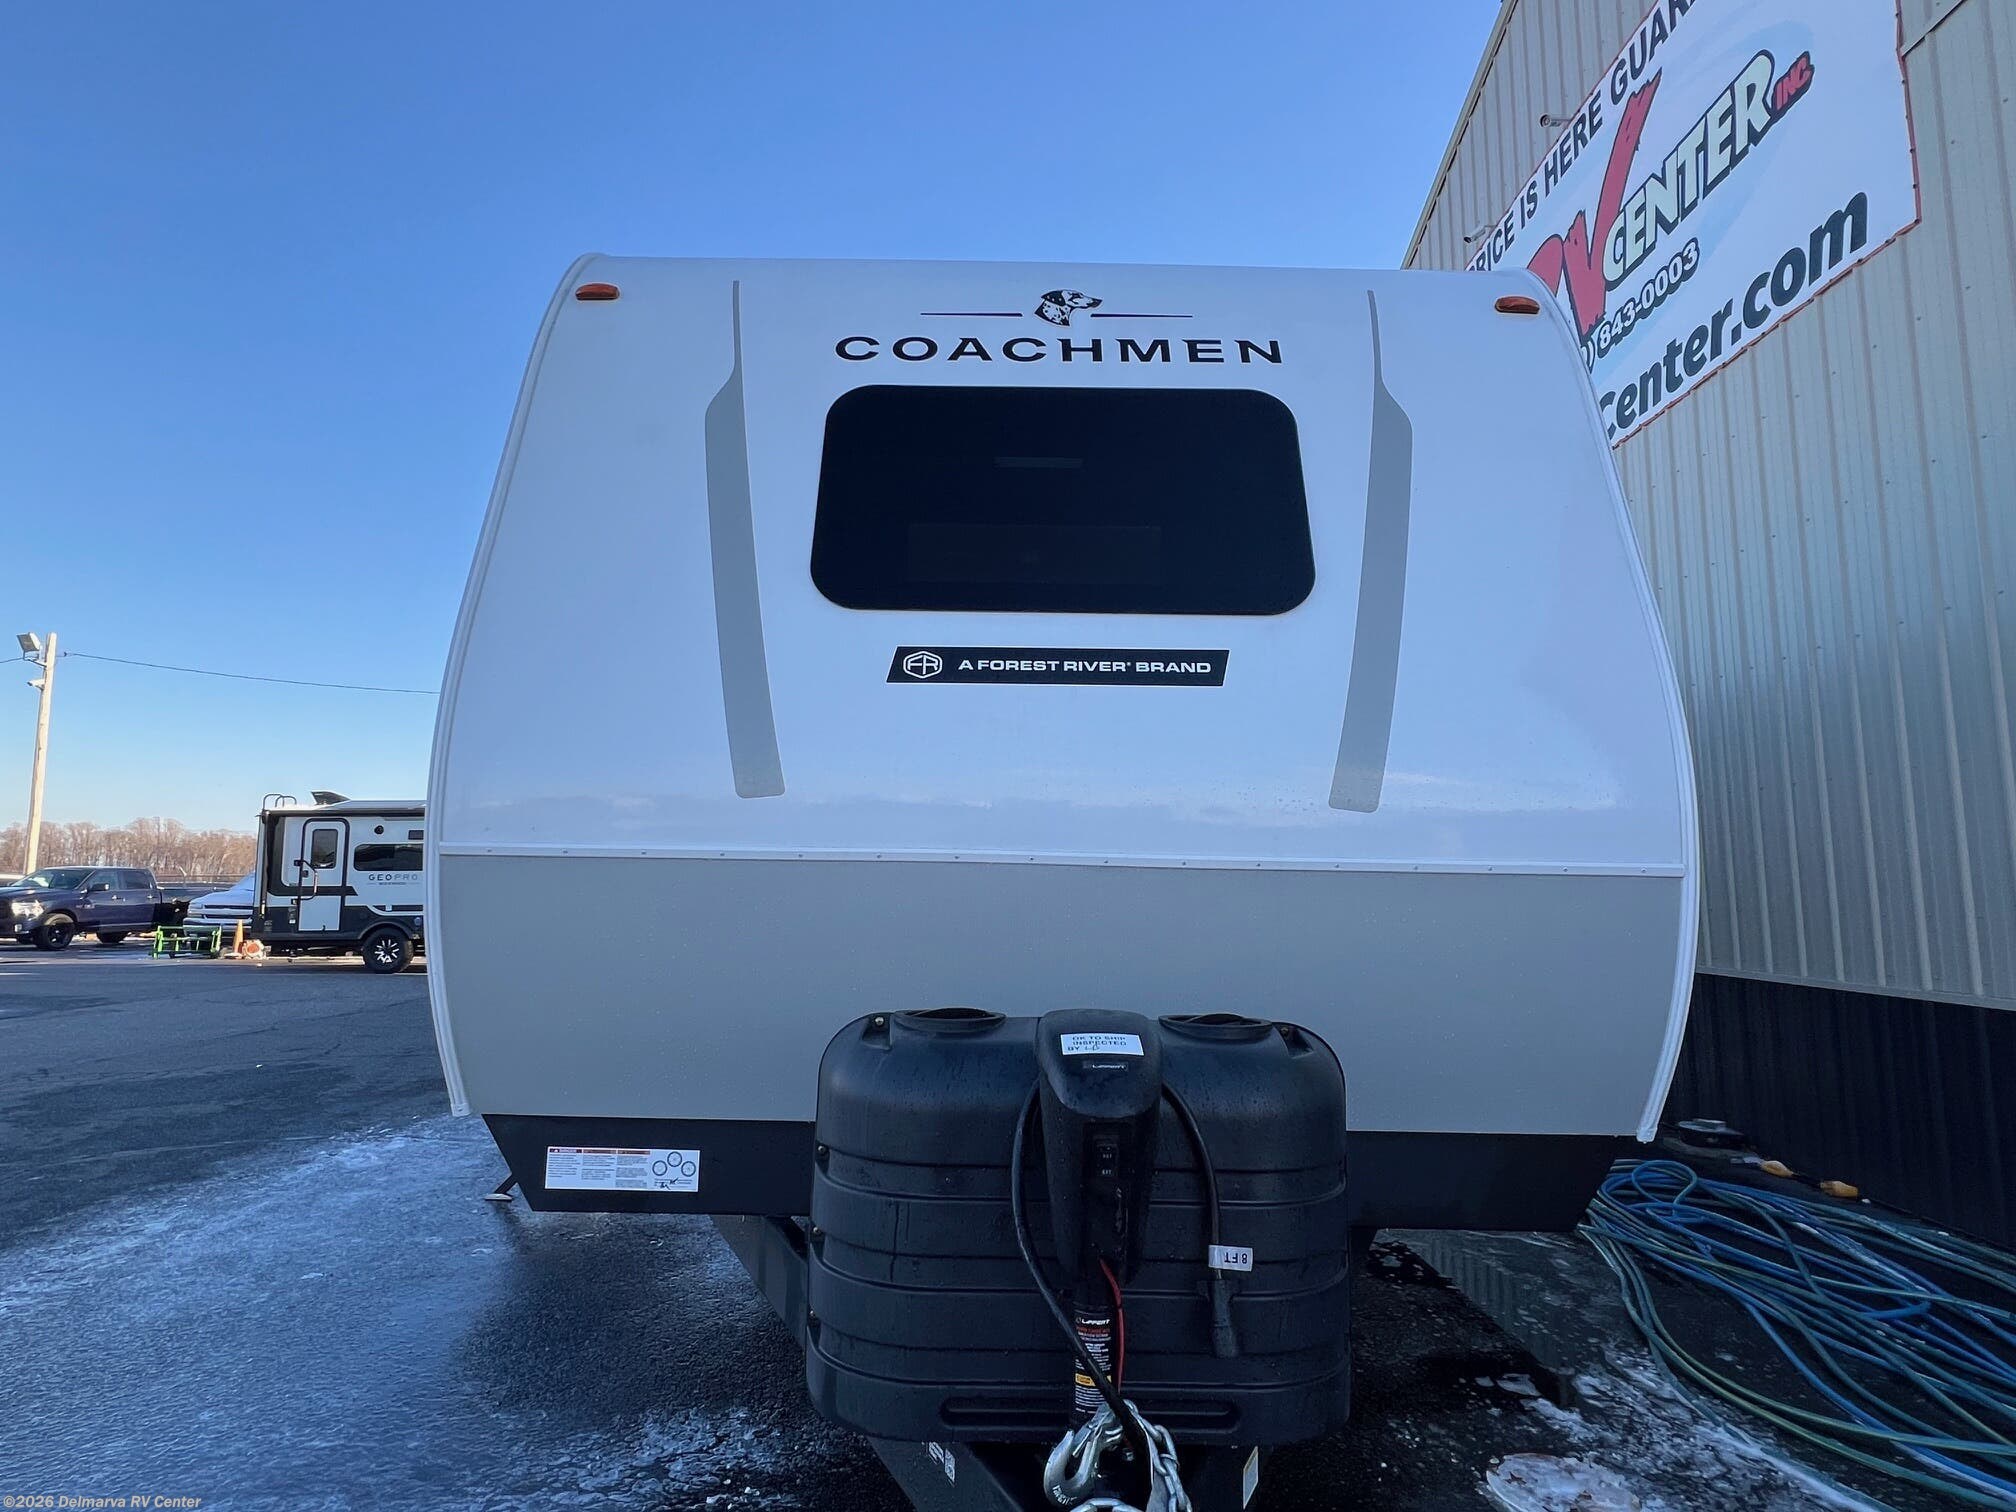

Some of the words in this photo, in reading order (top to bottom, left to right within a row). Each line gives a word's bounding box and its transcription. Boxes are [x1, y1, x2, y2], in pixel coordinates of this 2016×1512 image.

[1468, 210, 1515, 271] RICE
[1520, 180, 1538, 230] IS
[1544, 89, 1603, 198] HERE
[1602, 49, 1775, 286] CENTER
[835, 336, 1284, 365] COACHMEN
[957, 659, 974, 671] A
[977, 660, 1060, 671] FOREST
[1135, 662, 1212, 673] BRAND
